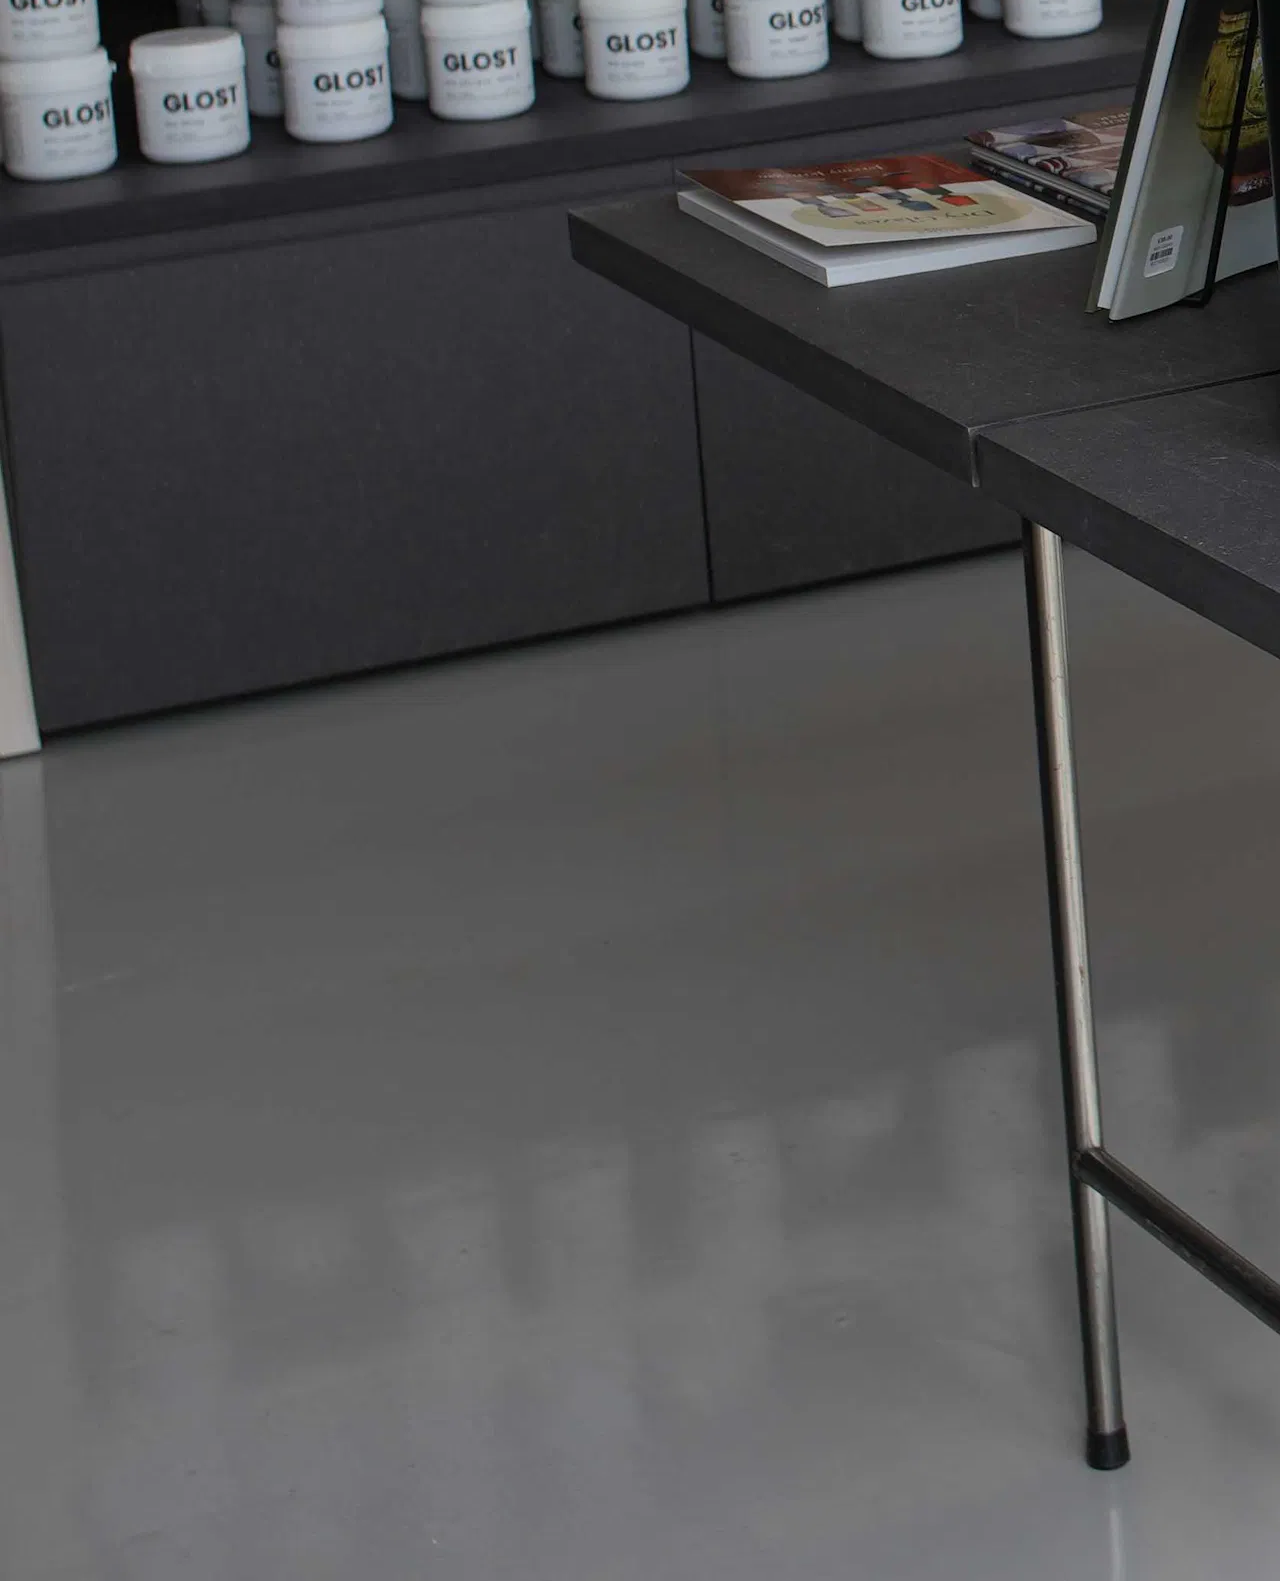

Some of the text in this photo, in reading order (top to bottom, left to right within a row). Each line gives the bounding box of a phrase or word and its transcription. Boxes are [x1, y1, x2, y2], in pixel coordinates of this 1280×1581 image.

[606, 29, 678, 52] GLOST
[444, 48, 517, 72] GLOST
[313, 65, 385, 92] GLOST
[163, 86, 238, 112] GLOST
[43, 98, 113, 129] GLOST
